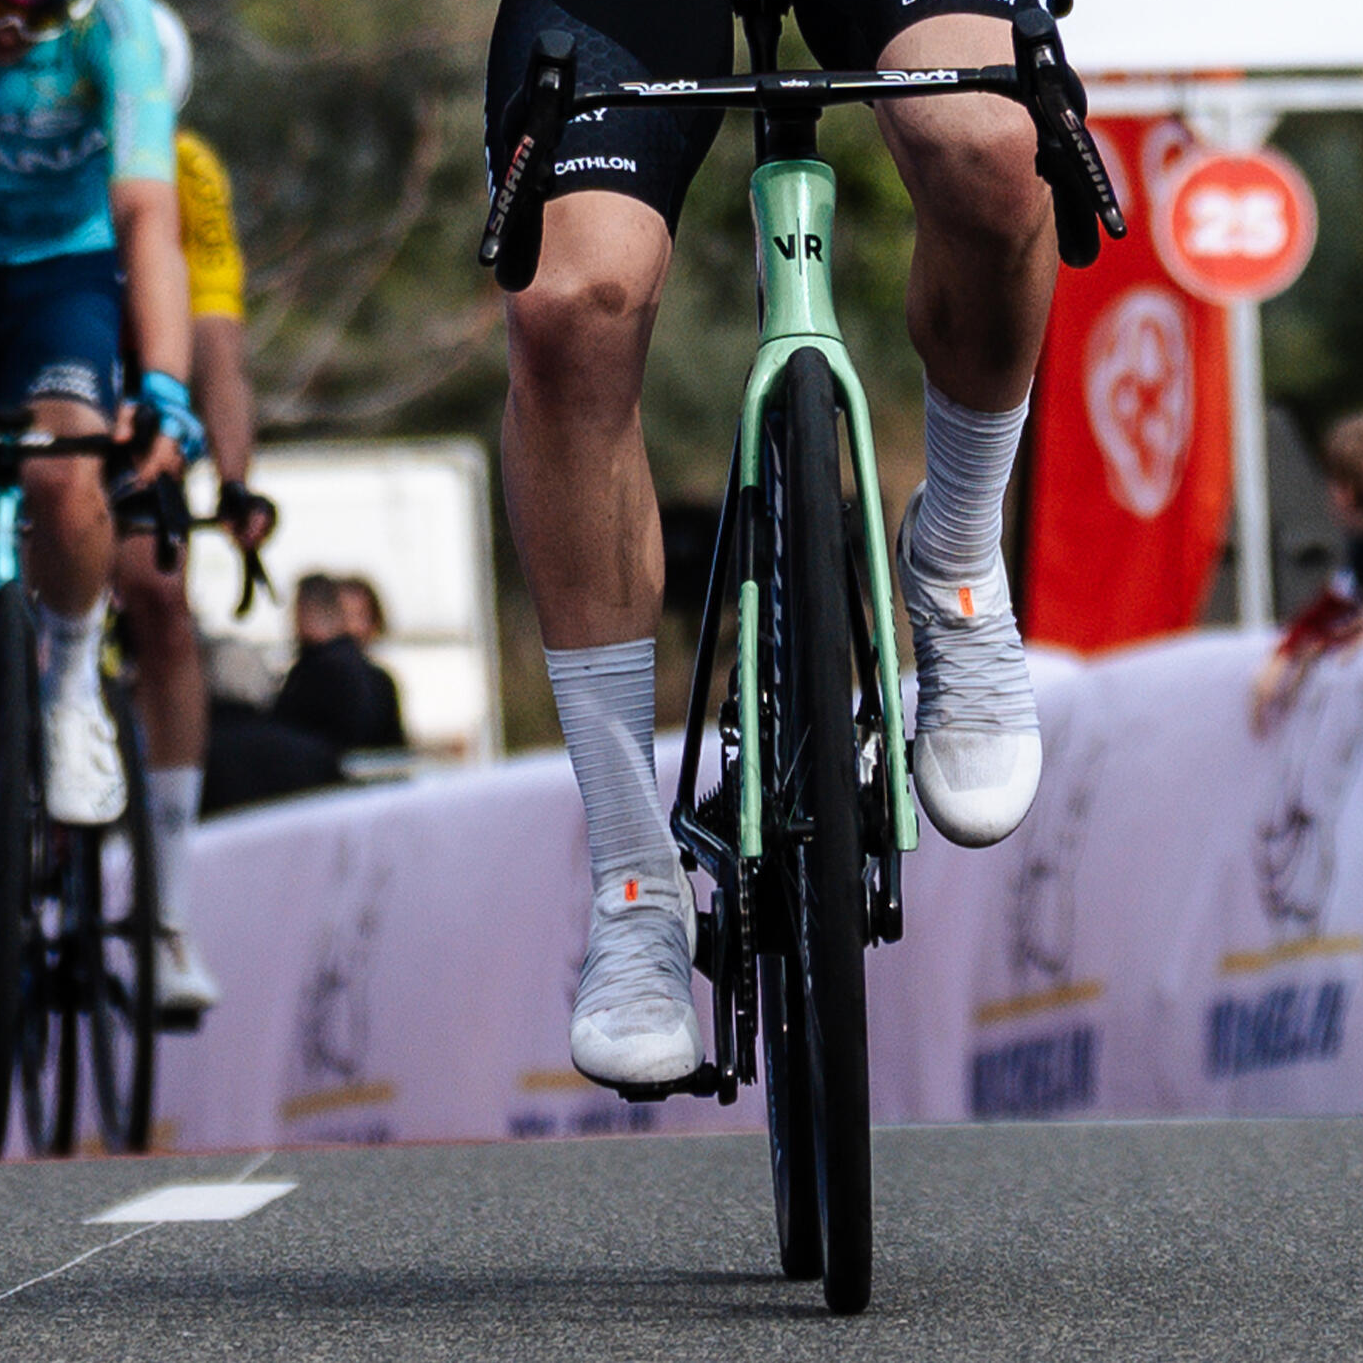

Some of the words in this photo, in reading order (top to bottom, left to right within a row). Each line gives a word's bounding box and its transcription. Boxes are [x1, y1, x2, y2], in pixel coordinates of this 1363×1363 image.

[489, 134, 535, 236] SRAM
[553, 156, 637, 175] CATHLON
[1185, 187, 1288, 257] 25
